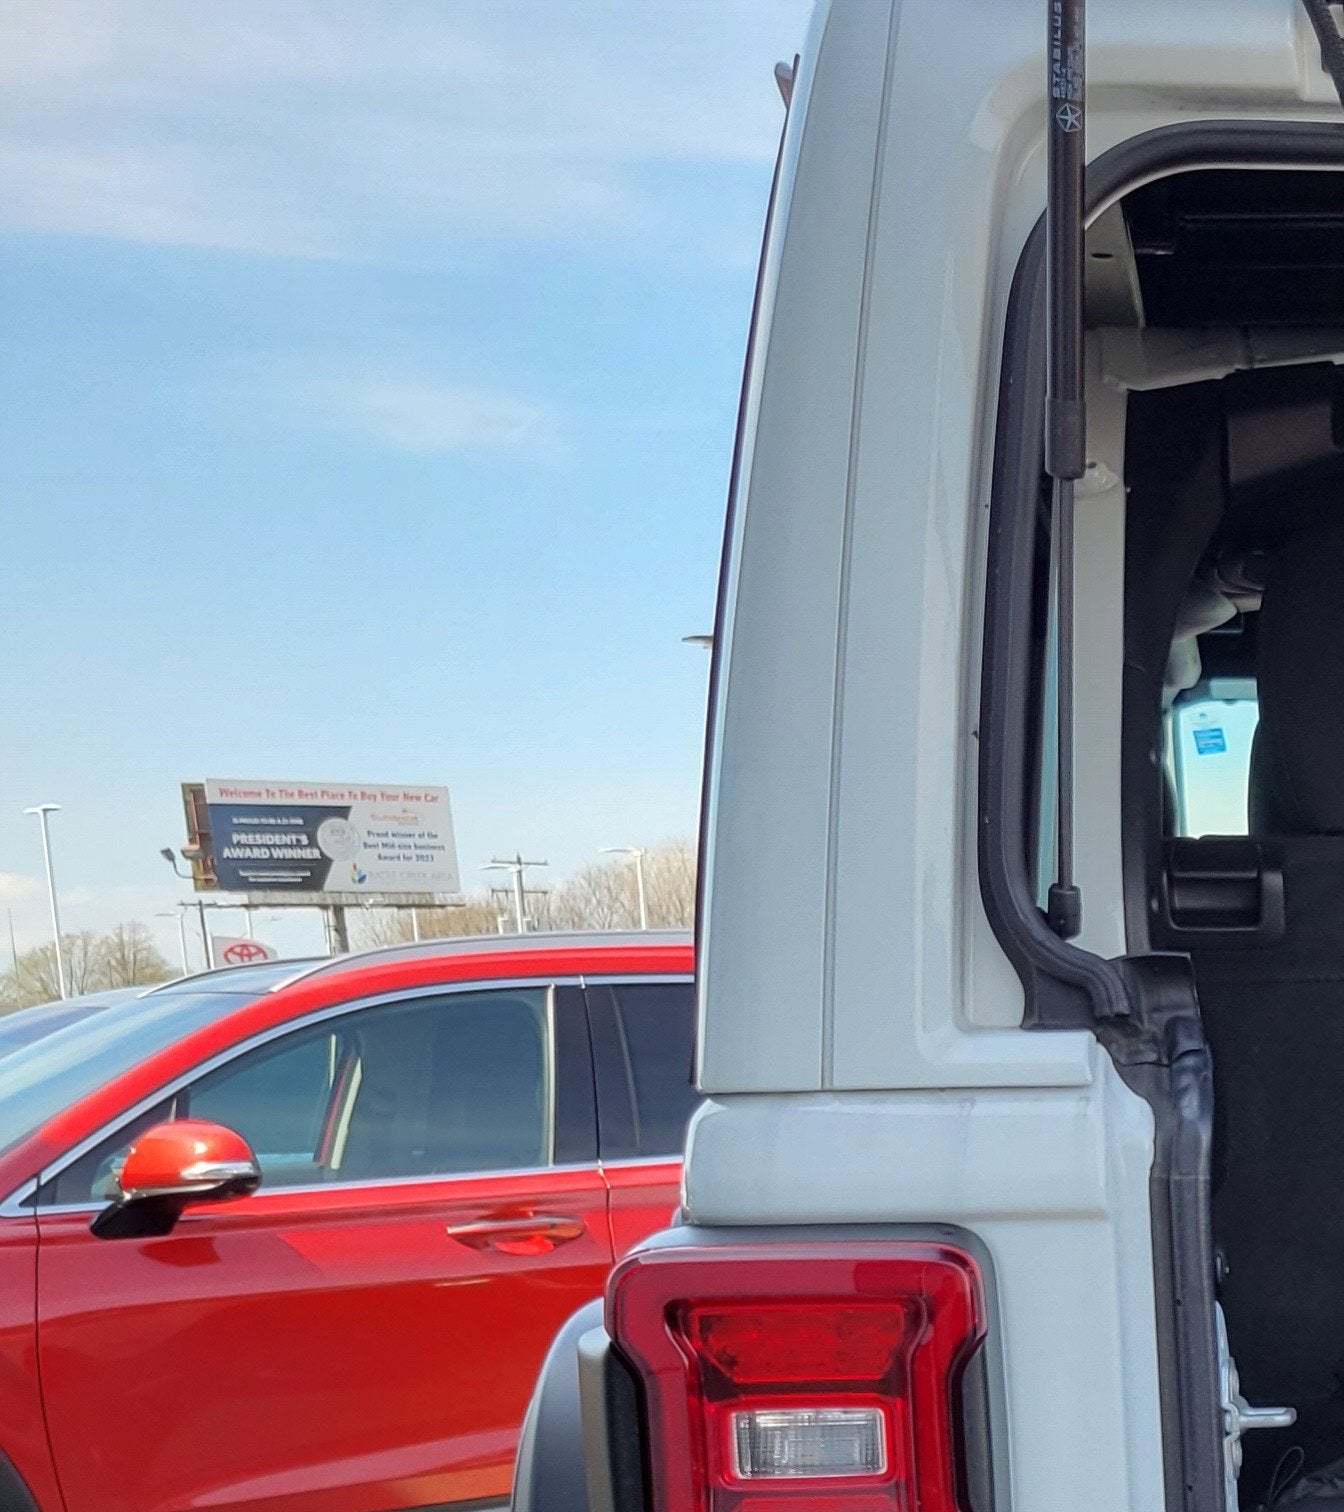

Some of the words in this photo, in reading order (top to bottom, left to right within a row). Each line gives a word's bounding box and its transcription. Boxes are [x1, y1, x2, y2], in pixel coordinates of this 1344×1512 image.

[1052, 1, 1063, 99] STABILUS
[219, 787, 261, 798] Welcome
[266, 788, 275, 798] To
[279, 789, 294, 799] The
[298, 789, 317, 799] Best
[348, 791, 358, 801] To
[360, 791, 377, 803] Buy
[403, 792, 421, 802] New
[231, 832, 309, 846] PRESIDENT'S
[222, 846, 271, 859] AWARD
[271, 847, 322, 860] WINNER
